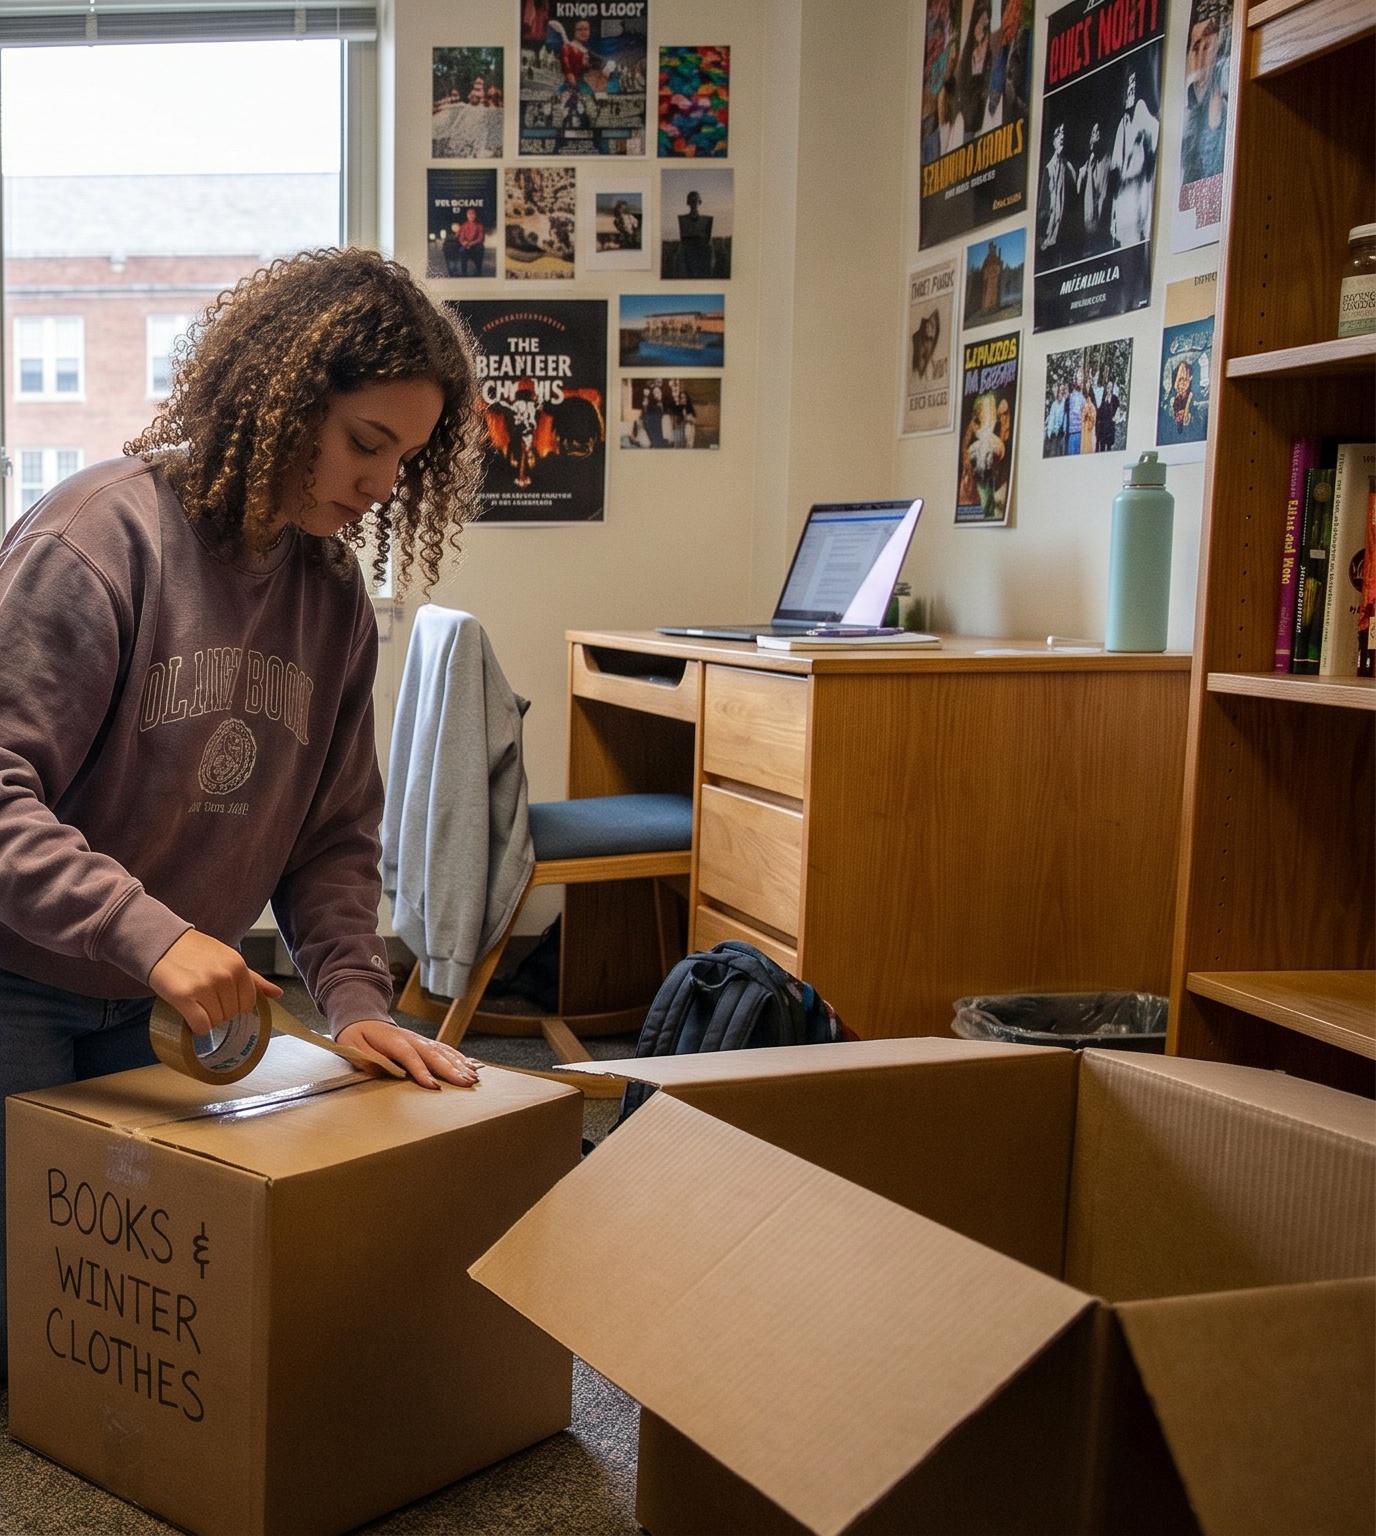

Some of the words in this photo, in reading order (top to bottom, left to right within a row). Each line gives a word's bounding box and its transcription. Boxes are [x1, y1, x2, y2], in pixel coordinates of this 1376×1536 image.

[507, 337, 540, 353] THE
[48, 1168, 173, 1264] BOOKS
[193, 1221, 210, 1279] &
[55, 1246, 202, 1355] WINTER
[46, 1307, 204, 1423] CLOTHES
